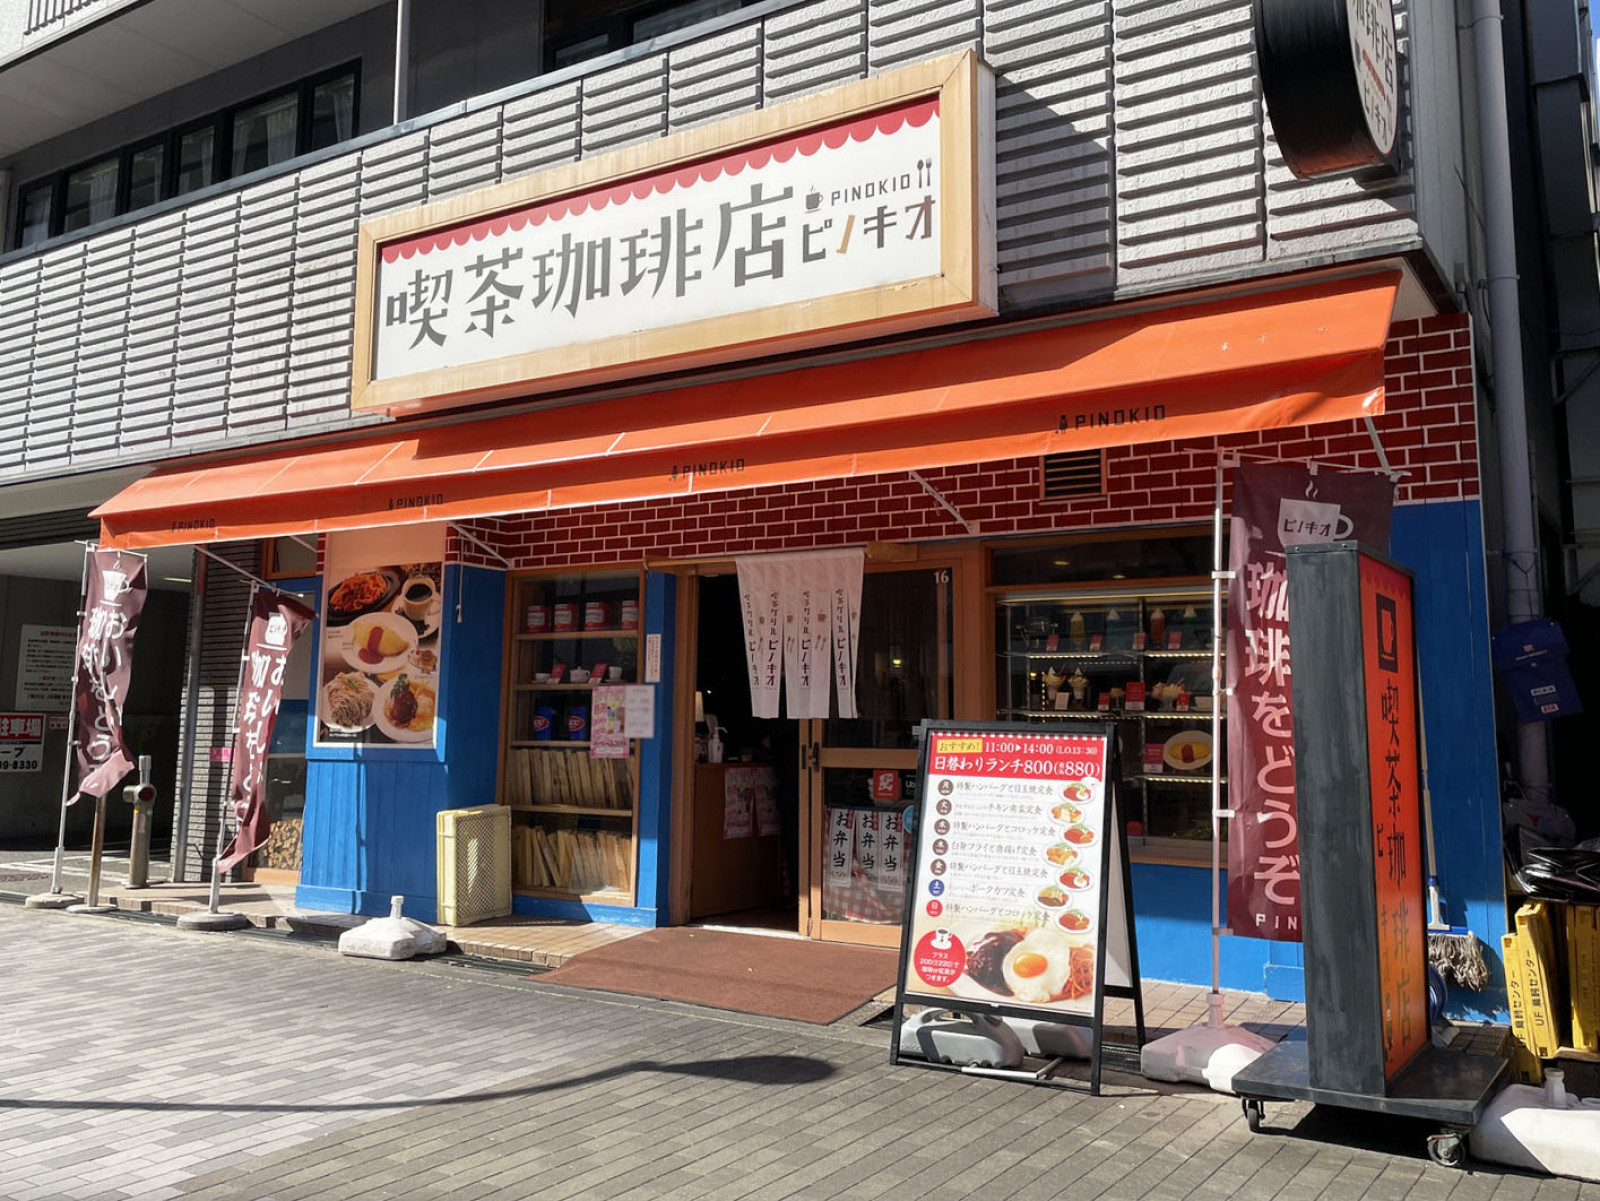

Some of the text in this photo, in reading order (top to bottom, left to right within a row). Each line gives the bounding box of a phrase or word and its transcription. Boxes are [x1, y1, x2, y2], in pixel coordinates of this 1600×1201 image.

[831, 173, 910, 206] PINOKIO
[802, 194, 936, 263] ピノキオ
[386, 183, 794, 350] 喫茶珈琲店
[1075, 405, 1165, 430] PINOKIO
[682, 458, 745, 478] PINOKIO
[396, 493, 443, 509] PINOKIO
[1284, 519, 1332, 537] ピノキオ
[933, 570, 950, 584] 16
[985, 742, 1015, 753] 11:00
[1023, 743, 1054, 755] 14:00
[1245, 561, 1300, 906] 珈琲をどうぞ
[832, 811, 849, 868] お弁当
[861, 813, 876, 870] お弁当
[883, 814, 899, 872] お弁当
[1381, 677, 1411, 1046] 喫茶珈琲店
[1376, 822, 1391, 983] ピキオ
